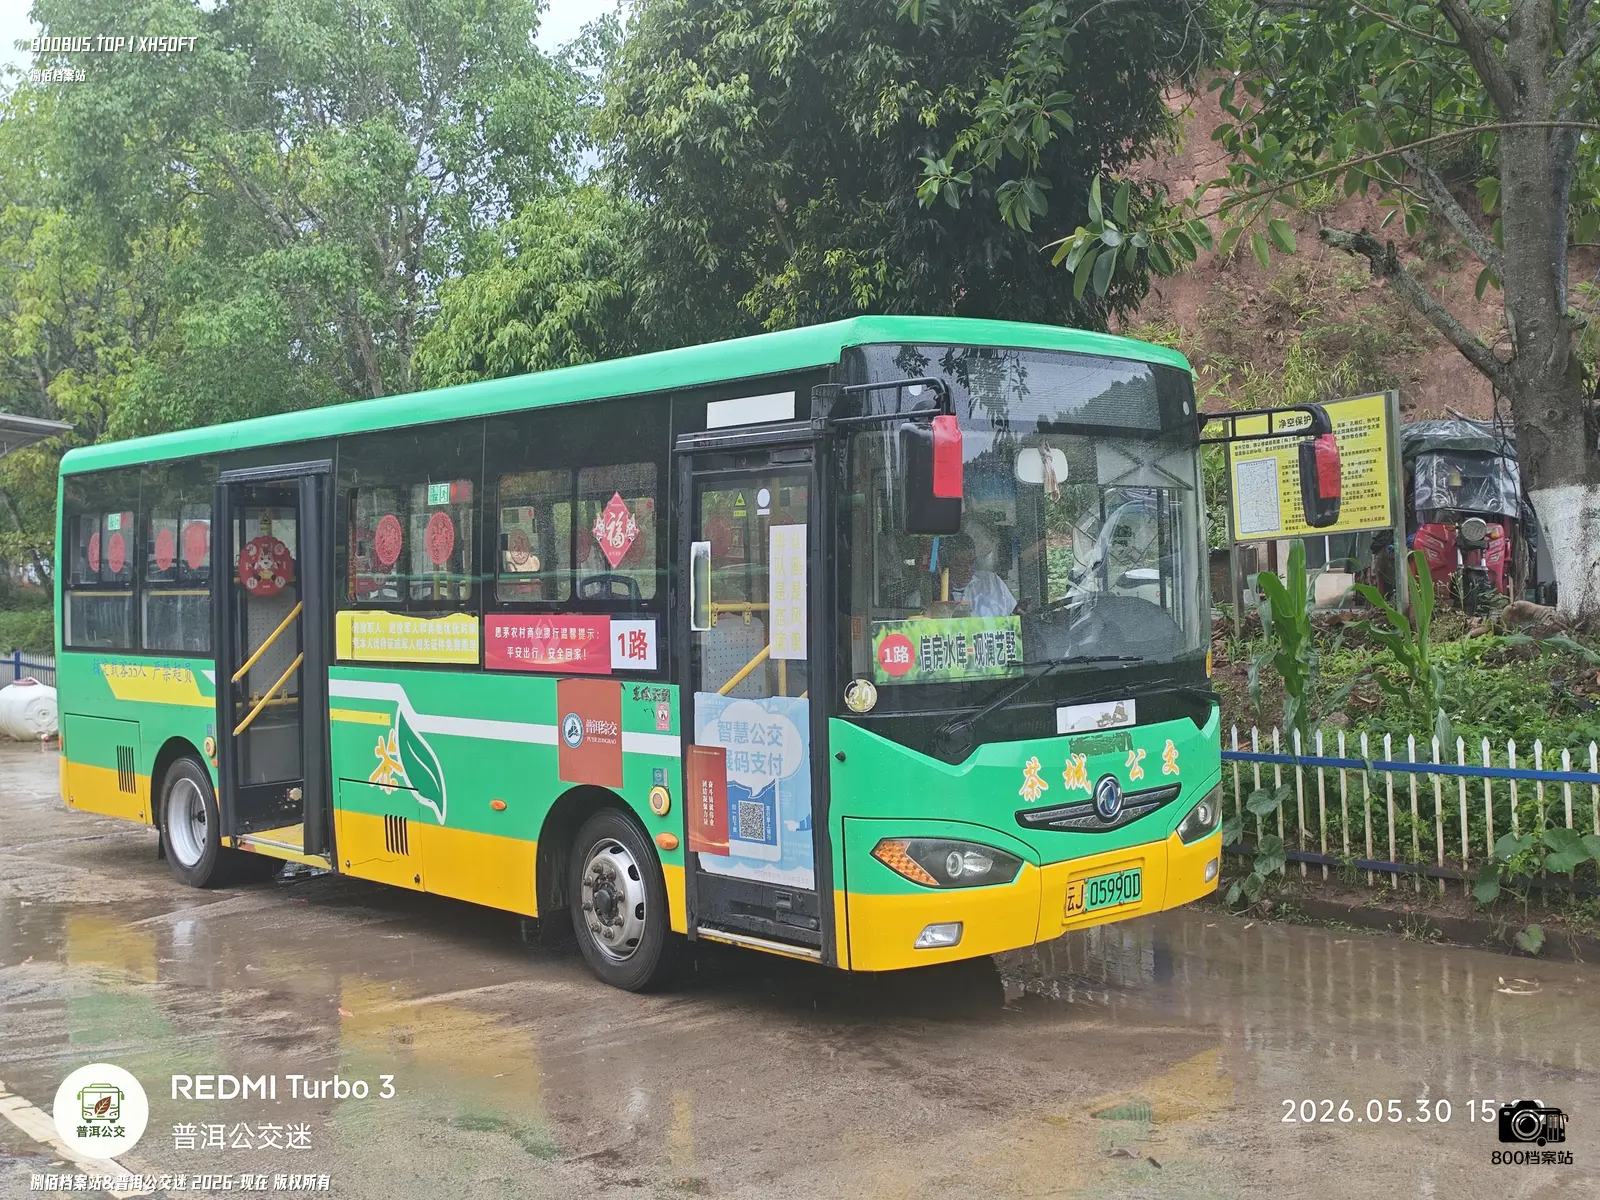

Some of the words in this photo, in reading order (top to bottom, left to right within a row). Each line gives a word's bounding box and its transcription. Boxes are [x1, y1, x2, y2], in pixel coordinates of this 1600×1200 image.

[1279, 415, 1312, 429] 净空保护
[605, 512, 624, 549] 福
[617, 630, 649, 661] 1路
[884, 646, 909, 663] 1路
[717, 721, 783, 747] 智慧公交
[1019, 739, 1180, 802] 茶城公交
